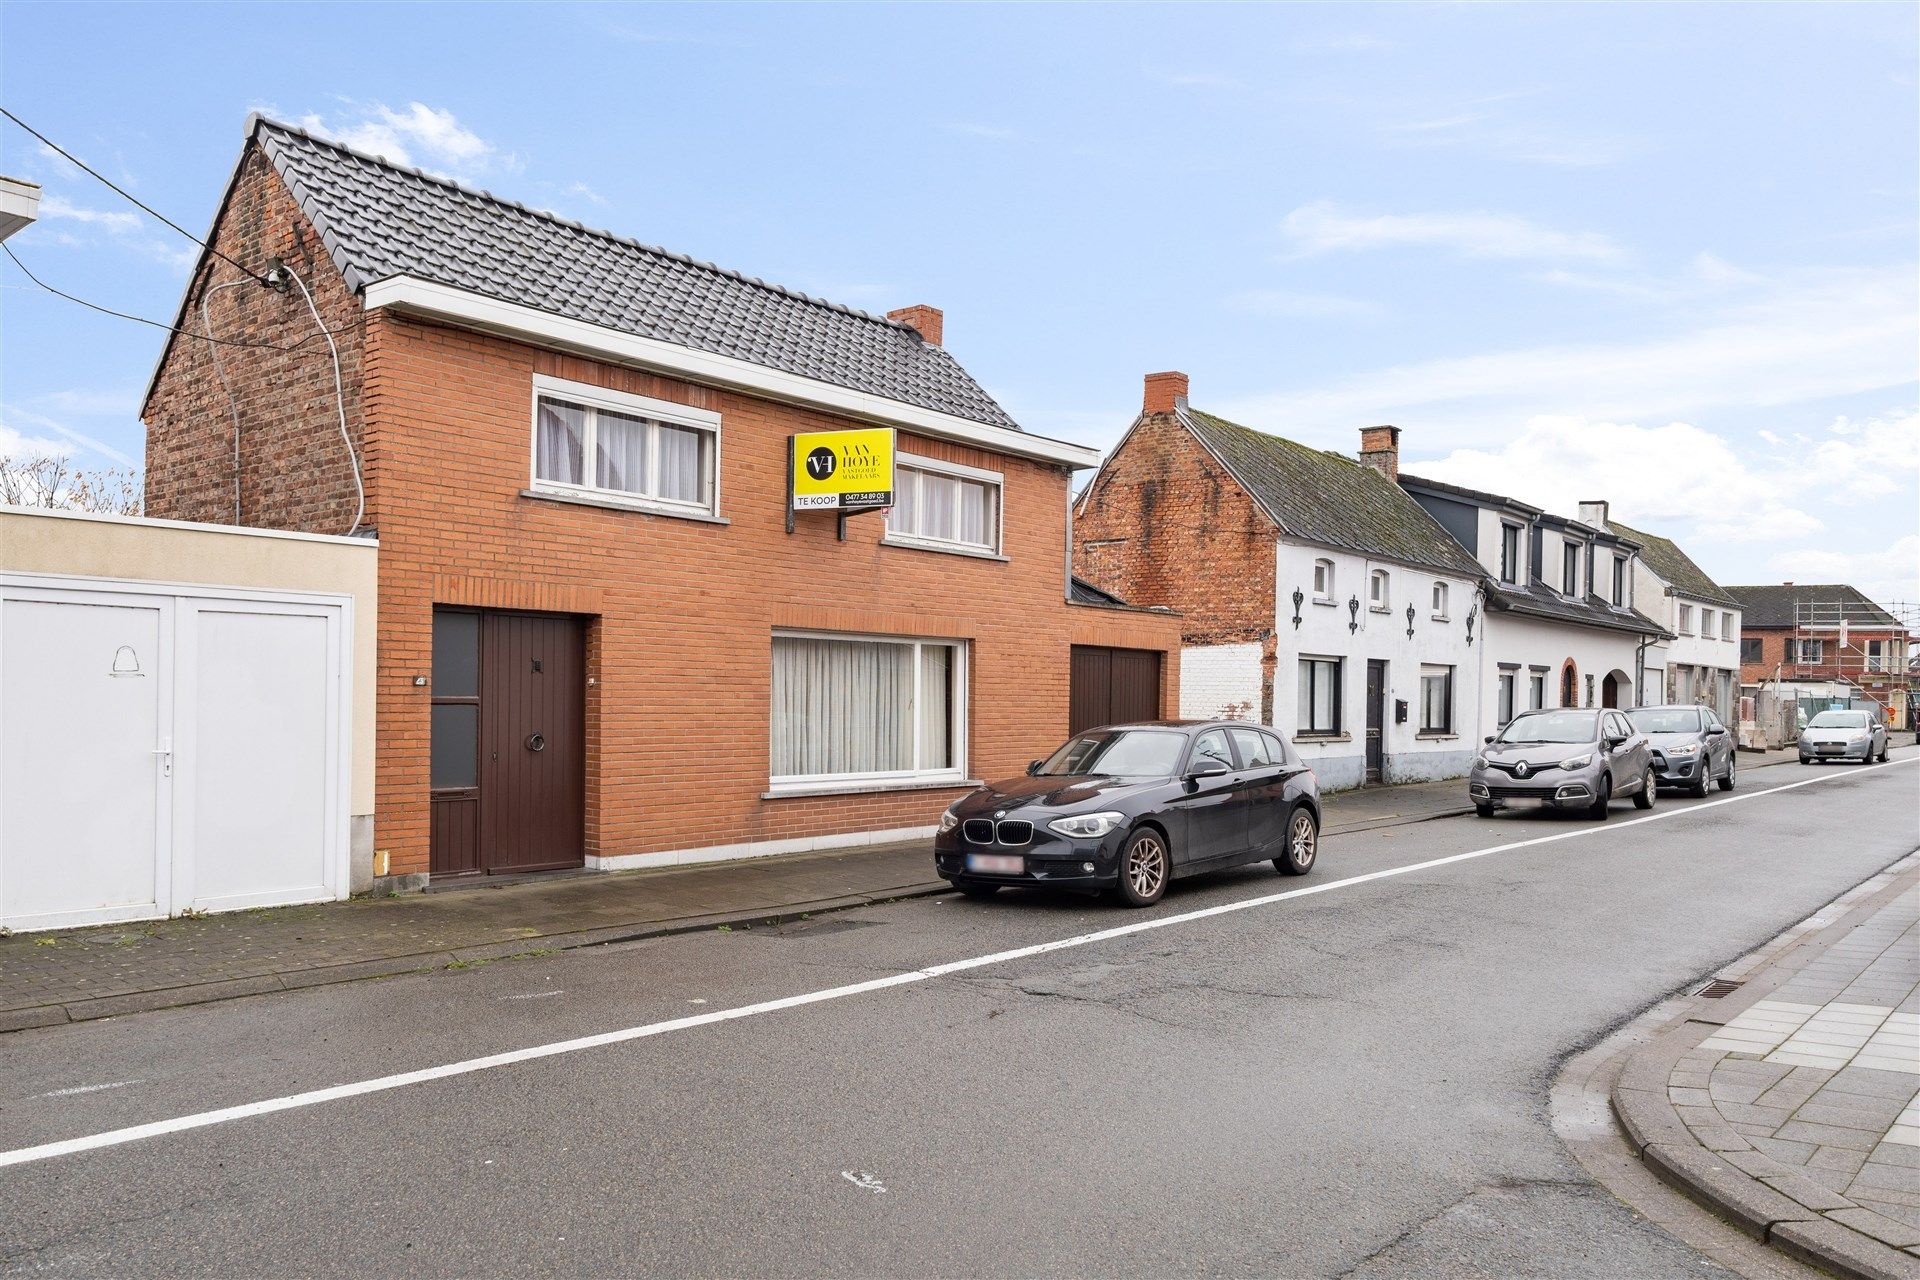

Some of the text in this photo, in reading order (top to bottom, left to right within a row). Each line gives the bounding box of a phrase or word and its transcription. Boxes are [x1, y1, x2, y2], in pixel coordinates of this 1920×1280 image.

[843, 444, 871, 455] VAN
[843, 456, 880, 467] HOYE
[798, 496, 836, 505] TE KOOP
